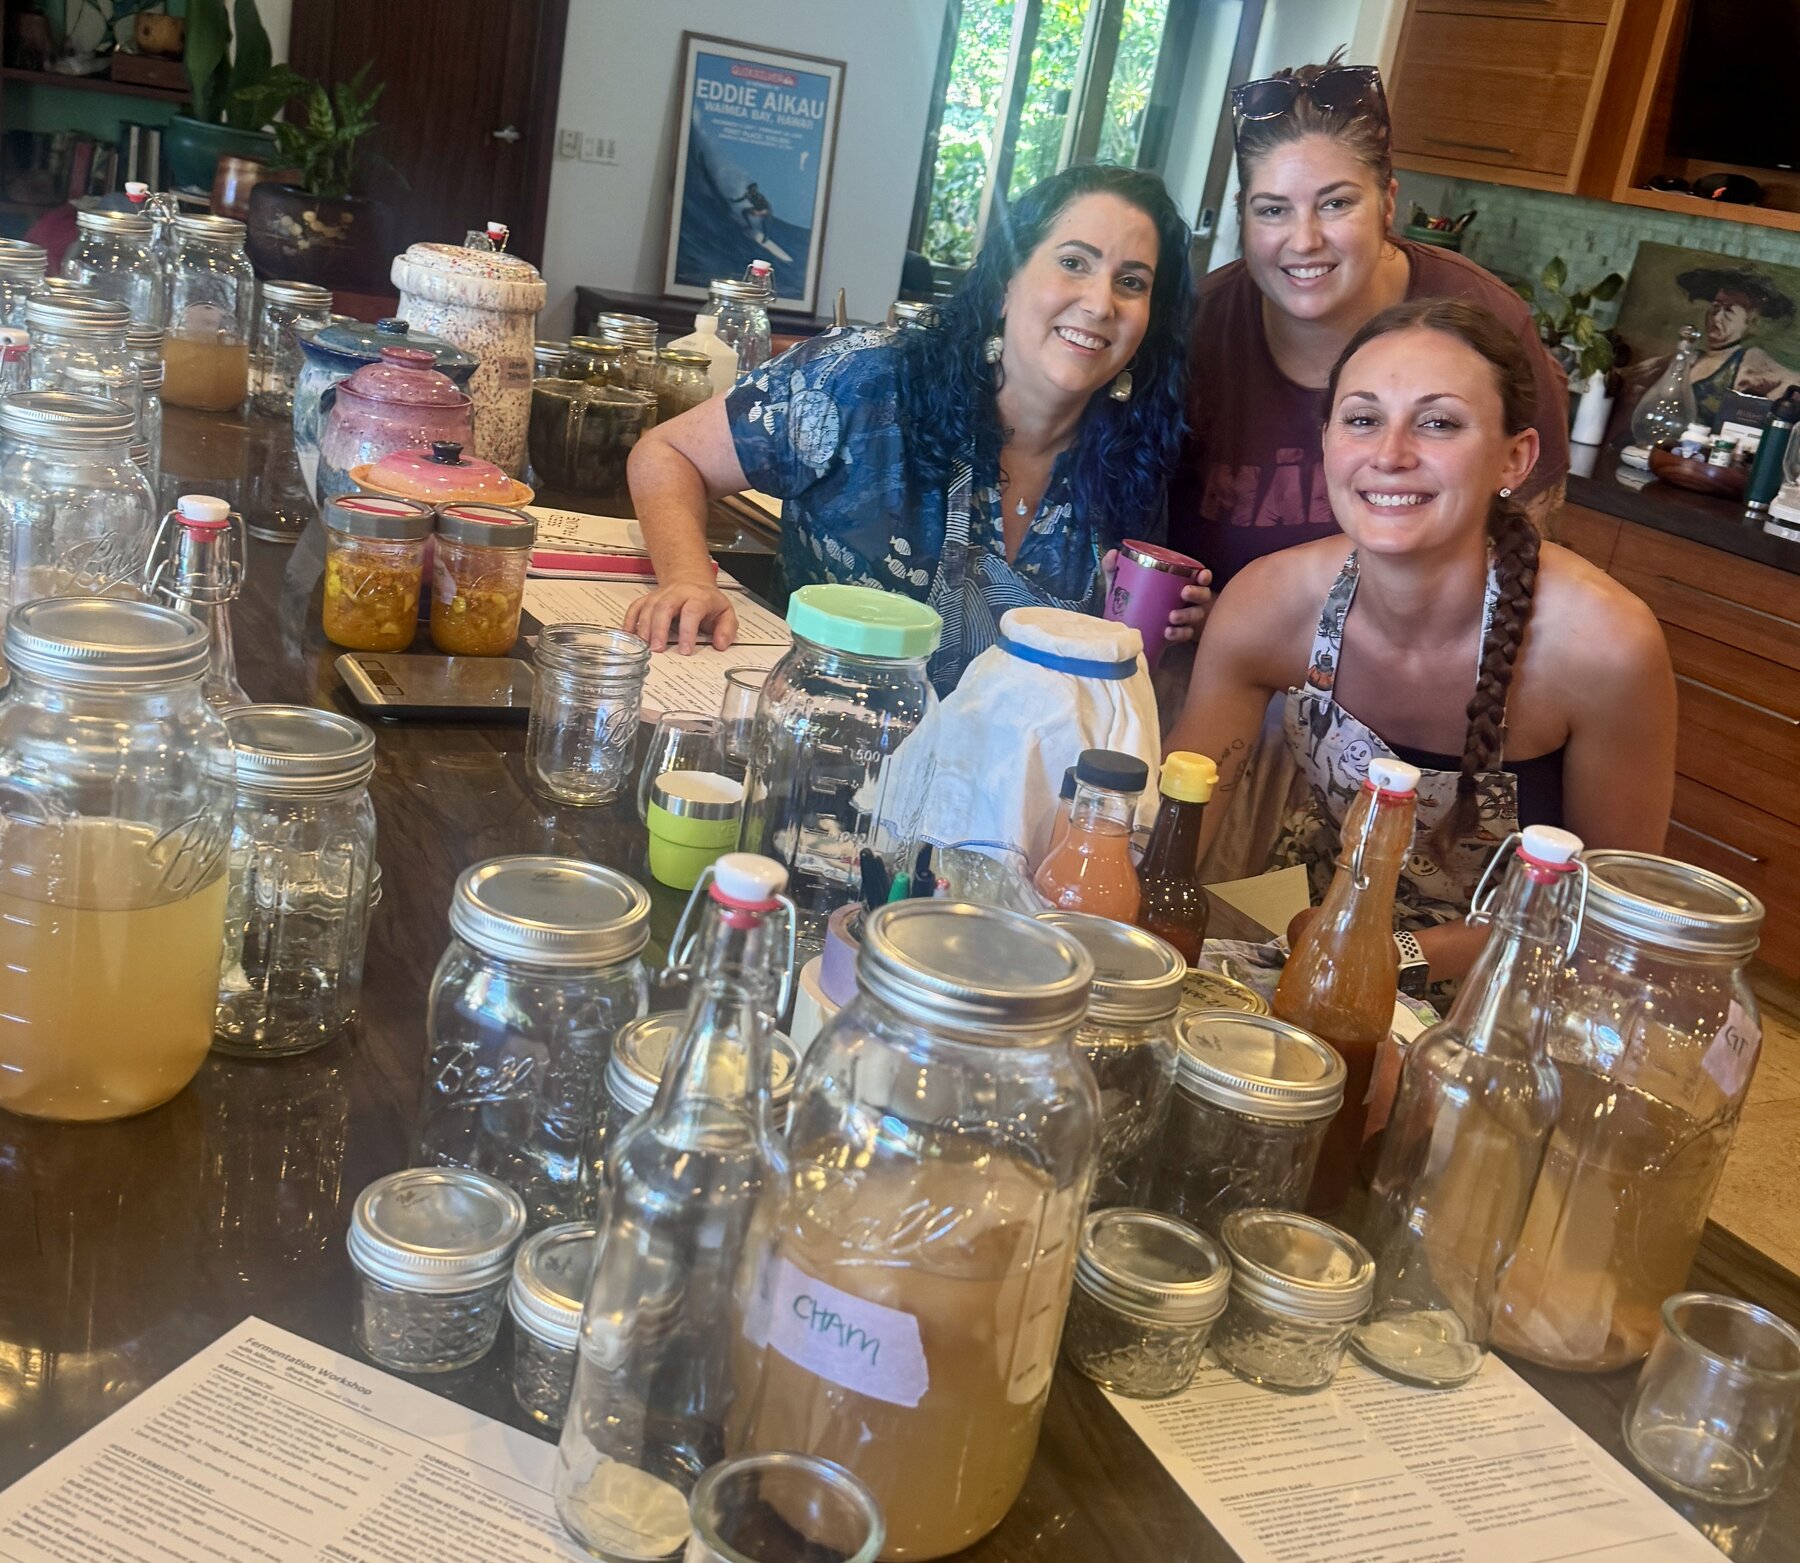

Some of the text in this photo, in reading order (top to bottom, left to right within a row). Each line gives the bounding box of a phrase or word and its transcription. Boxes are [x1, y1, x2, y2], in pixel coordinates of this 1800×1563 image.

[696, 78, 825, 119] EDDIE AIKAU
[704, 100, 749, 118] WAIMEA
[792, 1294, 881, 1366] CHAM
[245, 1337, 317, 1372] Fermentation
[318, 1366, 373, 1397] Workshop
[136, 1455, 185, 1480] FERMENTED
[423, 1453, 472, 1477] KOMBUCHA
